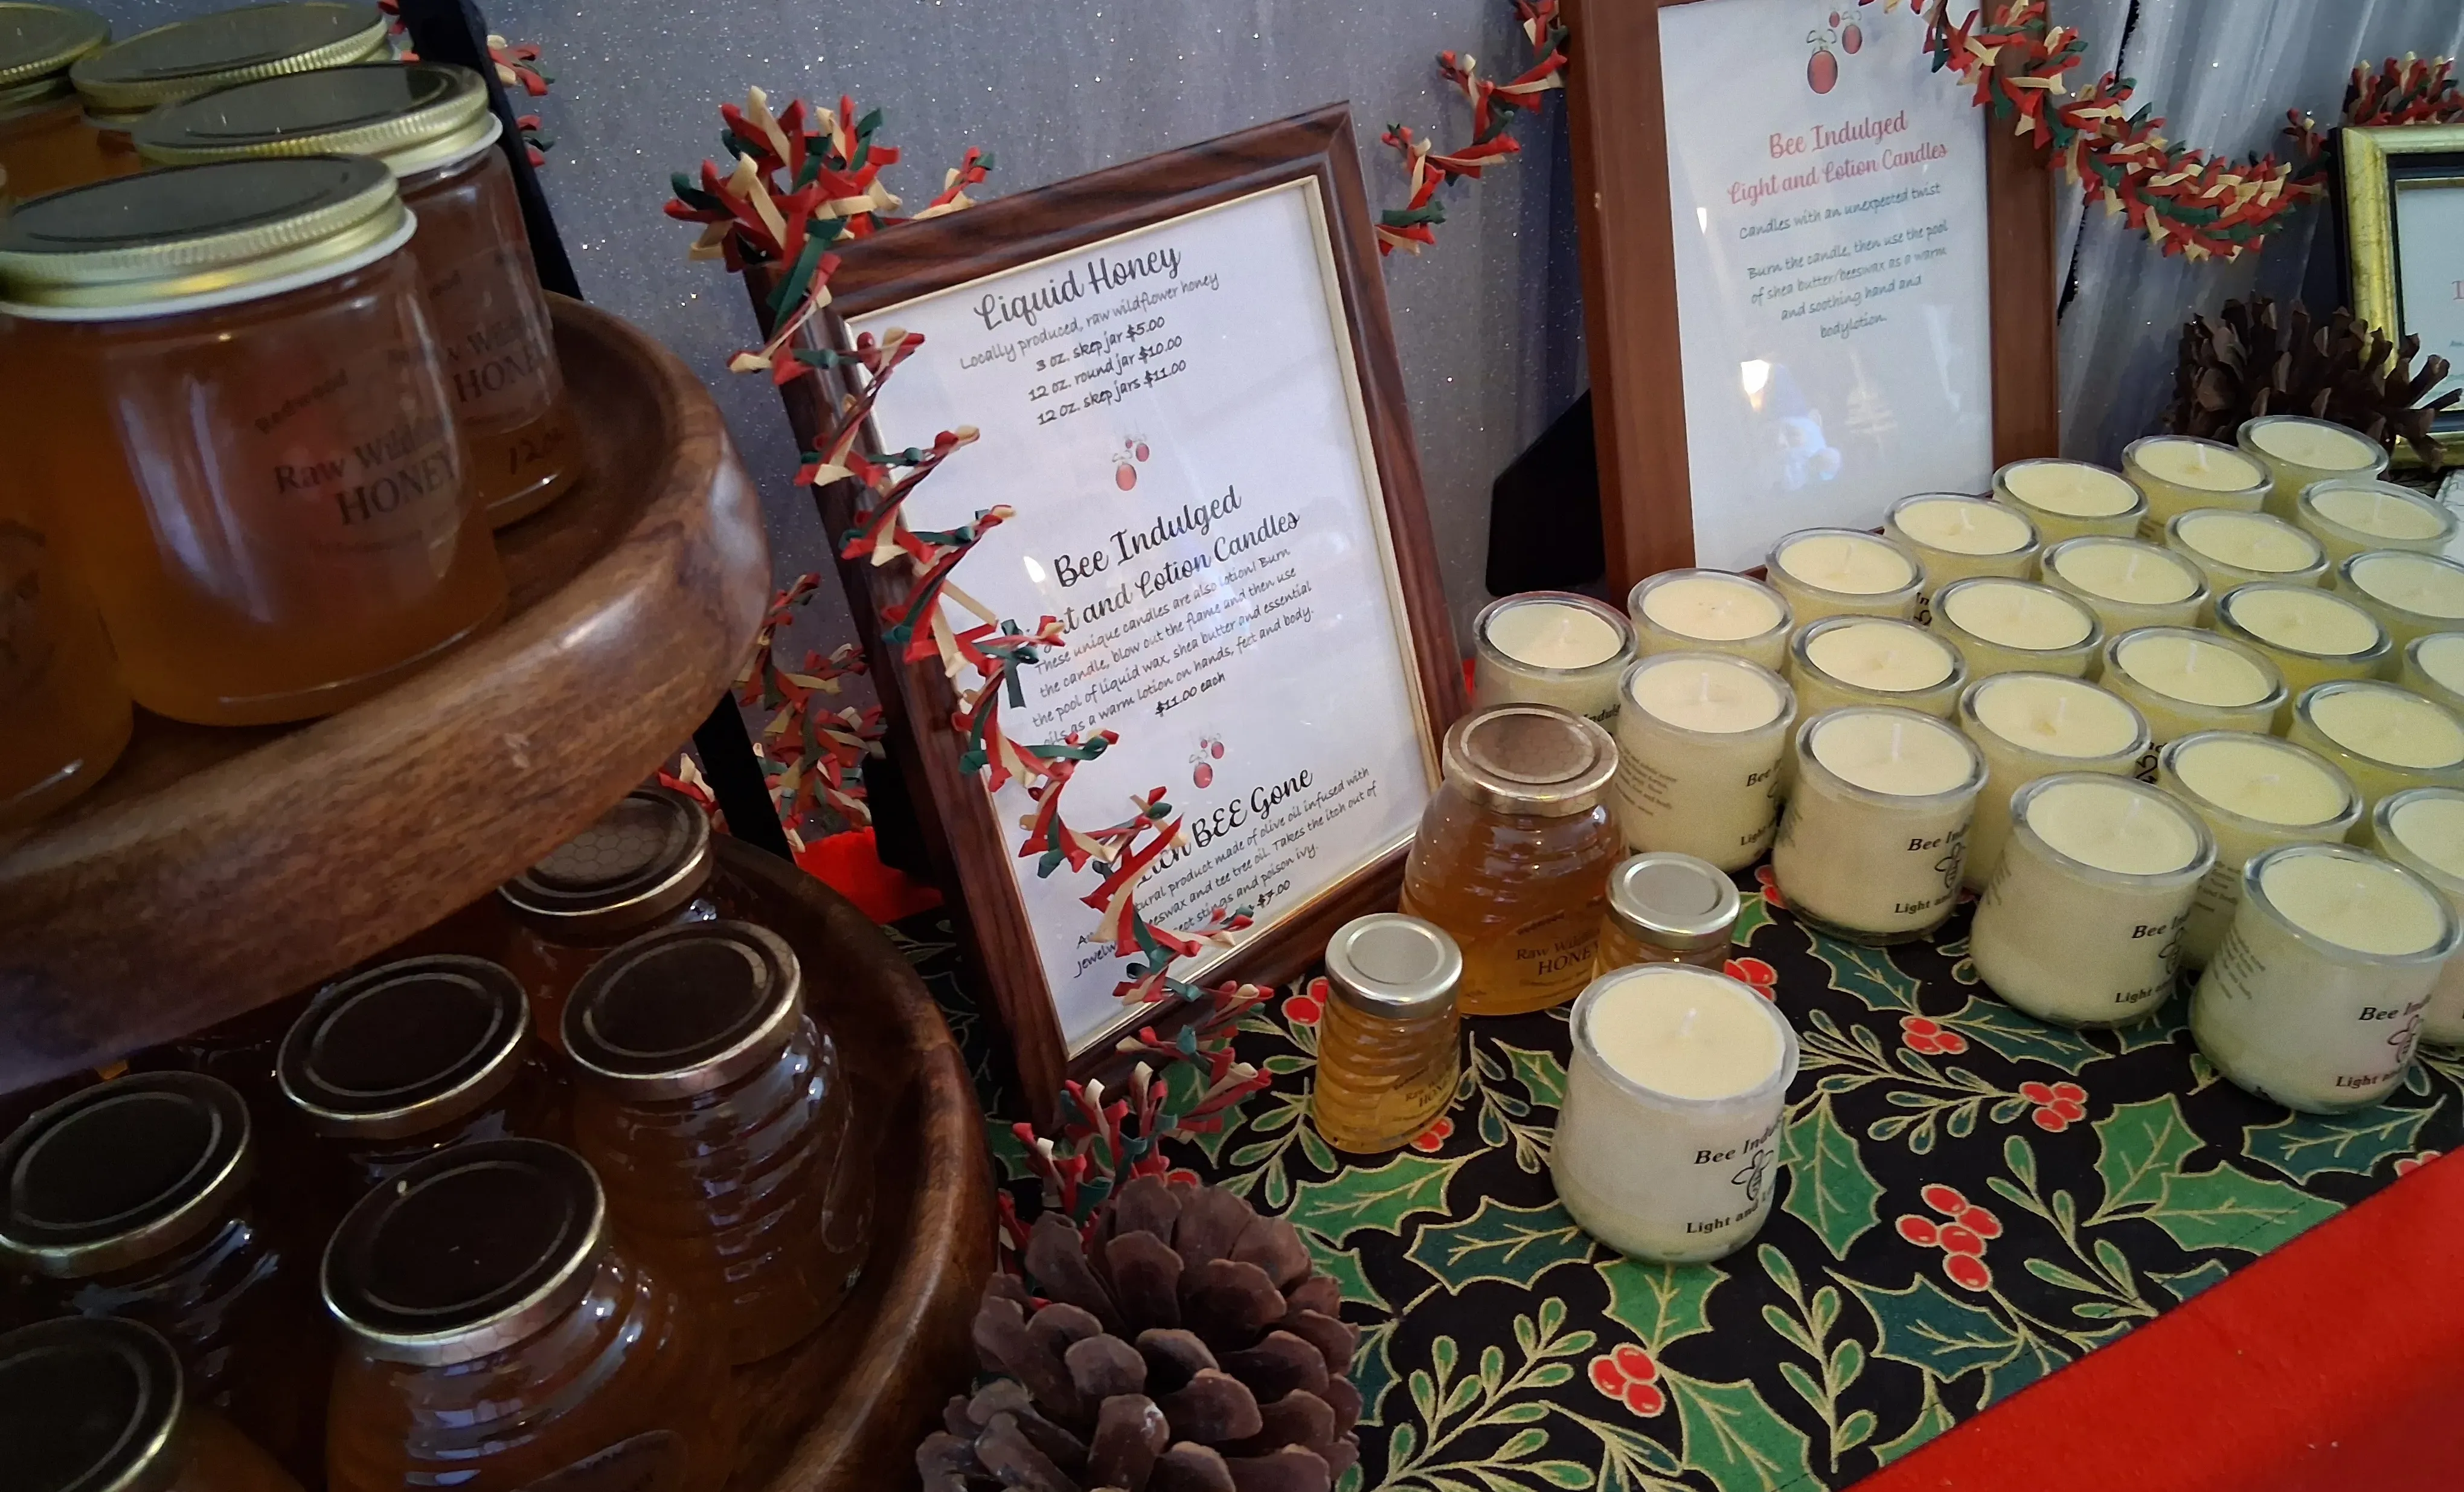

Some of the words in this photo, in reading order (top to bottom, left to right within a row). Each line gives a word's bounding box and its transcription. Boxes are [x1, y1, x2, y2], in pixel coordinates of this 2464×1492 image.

[1769, 133, 1807, 158] Bee
[1811, 109, 1908, 152] Indulged
[1727, 175, 1779, 205] Light
[1782, 167, 1819, 191] and
[1822, 158, 1879, 183] Lotion
[1882, 142, 1949, 170] Candles
[1740, 217, 1791, 239] Candles
[1794, 209, 1821, 227] with
[1824, 208, 1842, 220] an
[1844, 187, 1908, 215] unexpected
[1912, 182, 1942, 200] twist
[1747, 264, 1782, 280] Burn
[1786, 257, 1804, 270] the
[1854, 238, 1881, 254] then
[1884, 233, 1904, 246] use
[1906, 227, 1923, 240] the
[1926, 219, 1949, 241] pool
[1751, 287, 1765, 306] of
[1767, 283, 1793, 300] shea
[1888, 257, 1902, 269] as
[1904, 254, 1911, 265] a
[1914, 246, 1948, 262] warm
[974, 270, 1085, 331] Liquid
[1088, 248, 1181, 294] Honey
[1781, 302, 1806, 321] and
[1809, 291, 1862, 314] soothing
[1864, 278, 1896, 299] hand
[1898, 275, 1922, 290] and
[960, 342, 1016, 370] Locally
[1017, 320, 1084, 356] produced,
[1086, 309, 1109, 327] raw
[1112, 287, 1179, 318] wildflower
[1181, 272, 1219, 293] honey
[1036, 360, 1046, 371] 3
[1050, 351, 1070, 368] oz.
[1073, 339, 1103, 358] skep
[1104, 330, 1124, 359] jar
[1126, 316, 1166, 342] $5.00
[1028, 386, 1048, 401] 12
[1052, 377, 1071, 394] oz.
[1074, 359, 1113, 385] round
[1115, 352, 1136, 376] jar
[1138, 335, 1182, 362] $10.00
[1037, 411, 1056, 425] 12
[1059, 402, 1080, 417] oz.
[1083, 388, 1112, 408] skep
[1114, 379, 1141, 403] jars
[1143, 359, 1187, 388] $11.00
[274, 457, 346, 494] Raw
[1053, 548, 1109, 588] Bee
[1110, 484, 1242, 567] Indulged
[1083, 584, 1133, 623] and
[1134, 552, 1212, 598] Lotion
[1213, 512, 1300, 562] Candles
[1034, 650, 1071, 674] These
[1073, 627, 1121, 657] unique
[1123, 605, 1170, 632] candles
[1173, 593, 1192, 609] are
[1193, 583, 1217, 600] also
[1259, 549, 1291, 568] Burn
[1039, 681, 1060, 698] the
[1064, 660, 1109, 687] candle,
[1111, 642, 1140, 663] blow
[1143, 632, 1163, 649] out
[1165, 619, 1184, 638] the
[1186, 604, 1221, 631] flame
[1223, 588, 1246, 608] and
[1248, 578, 1275, 597] then
[1277, 567, 1296, 582] use
[1032, 710, 1054, 727] the
[1056, 695, 1082, 721] pool
[1085, 684, 1098, 704] of
[1100, 666, 1140, 693] liquid
[1143, 657, 1170, 674] wax,
[1173, 641, 1199, 658] shea
[1202, 620, 1235, 644] butter
[1239, 605, 1261, 626] and
[1263, 580, 1312, 615] essential
[1044, 730, 1067, 745] oils
[1071, 721, 1086, 733] as
[1089, 715, 1096, 725] a
[1098, 698, 1135, 720] warm
[1137, 677, 1173, 699] lotion
[1176, 669, 1192, 683] on
[1193, 649, 1234, 672] hands,
[1236, 632, 1257, 654] feet
[1259, 622, 1282, 640] and
[1283, 606, 1315, 628] body.
[1155, 686, 1198, 717] $11.00
[1200, 672, 1226, 692] each
[1167, 860, 1213, 897] product
[1215, 841, 1245, 865] made
[1247, 827, 1258, 846] of
[1260, 817, 1286, 838] olive
[1288, 805, 1302, 822] oil
[1303, 779, 1345, 812] infused
[1346, 767, 1370, 786] with
[1192, 799, 1248, 848] BEE
[1251, 769, 1314, 820] Gone
[1189, 879, 1213, 902] and
[1233, 859, 1253, 876] tree
[1272, 827, 1306, 851] Takes
[1307, 816, 1324, 832] the
[1326, 803, 1346, 821] itch
[1348, 791, 1365, 809] out
[1367, 780, 1377, 797] of
[1907, 838, 1942, 852] Bee
[1236, 875, 1259, 898] and
[1260, 857, 1295, 887] poison
[1296, 844, 1319, 859] ivy.
[1257, 879, 1291, 909] $7.00
[1895, 900, 1931, 915] Light
[2131, 924, 2167, 939] Bee
[2115, 988, 2153, 1003] Light
[2358, 1006, 2399, 1021] Bee
[2335, 1074, 2379, 1089] Light
[1693, 1150, 1736, 1165] Bee
[1686, 1216, 1730, 1234] Light
